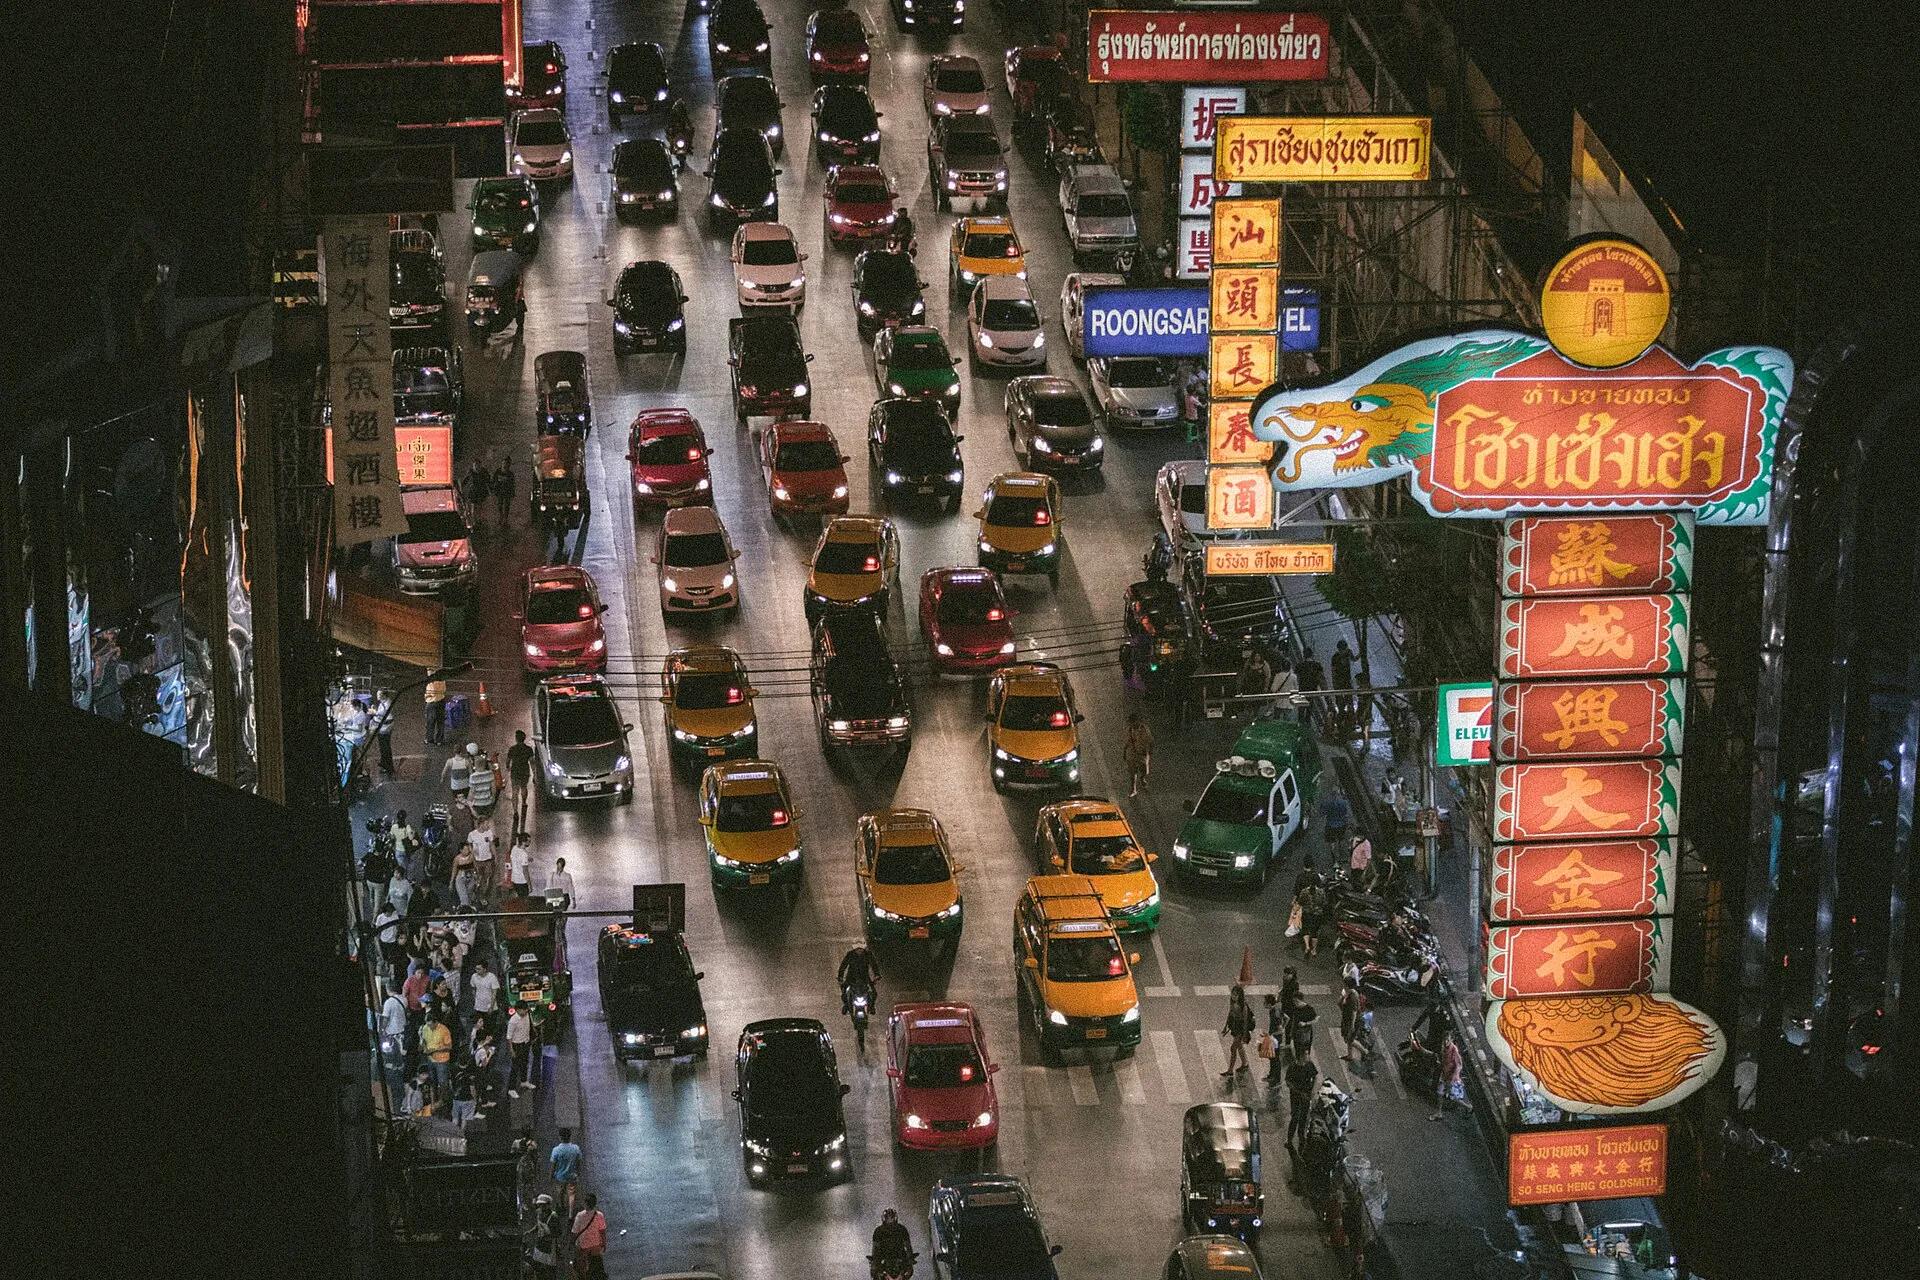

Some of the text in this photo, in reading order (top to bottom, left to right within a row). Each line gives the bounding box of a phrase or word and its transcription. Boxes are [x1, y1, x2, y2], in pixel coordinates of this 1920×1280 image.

[1097, 14, 1322, 75] รุ่งทรัพย์การท่องเที่ยว
[340, 235, 381, 530] 海外天魚翅酒樓
[1221, 214, 1265, 518] 汕頭長春酒
[1523, 382, 1692, 406] ห้างขายทอง
[1216, 552, 1249, 569] บริษัท
[1293, 551, 1324, 567] จำกัด
[1533, 522, 1639, 987] 蘇成興大金行
[1519, 1142, 1590, 1162] ห้างขายทอง
[1518, 1176, 1659, 1196] SO SENG HENG GOLDSMITH
